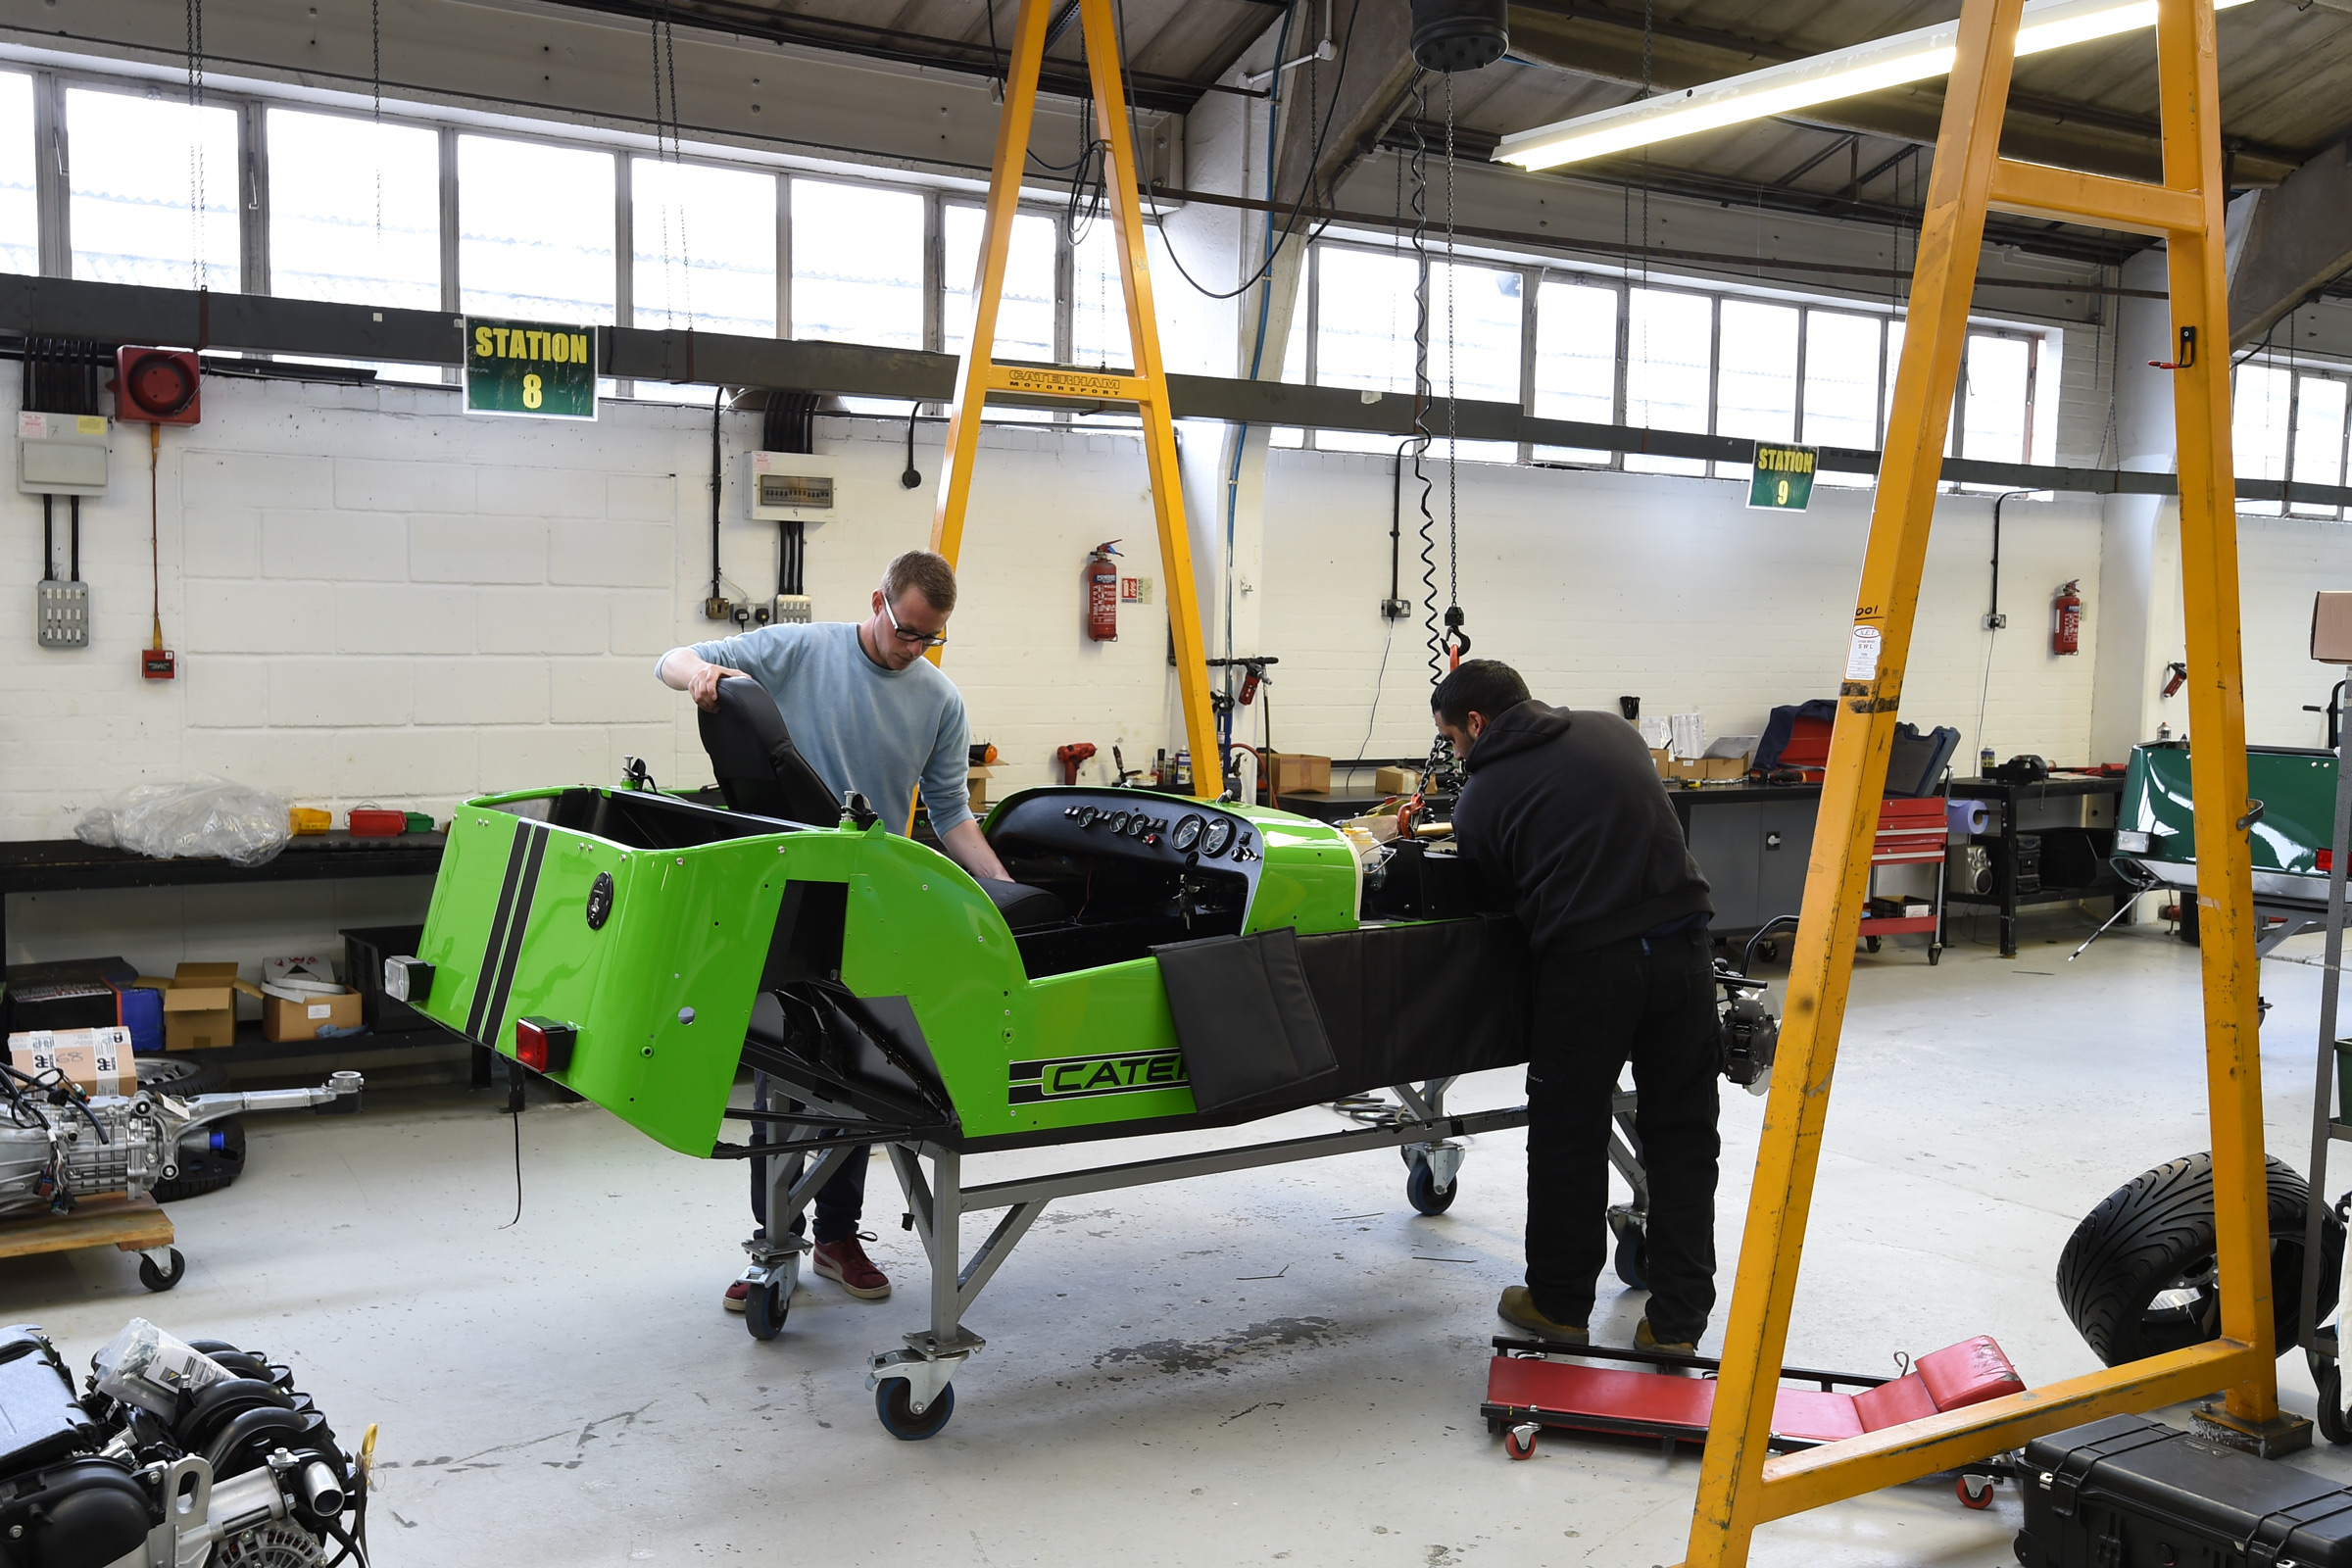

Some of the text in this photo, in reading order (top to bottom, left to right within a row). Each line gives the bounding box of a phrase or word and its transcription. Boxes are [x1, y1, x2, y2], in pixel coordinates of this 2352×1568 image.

[475, 326, 587, 364] STATION
[522, 373, 542, 409] 8
[1008, 369, 1120, 390] CATERHAM
[1009, 380, 1120, 396] MOTORSPORT
[1758, 448, 1814, 473] STATION
[1778, 480, 1789, 506] 9
